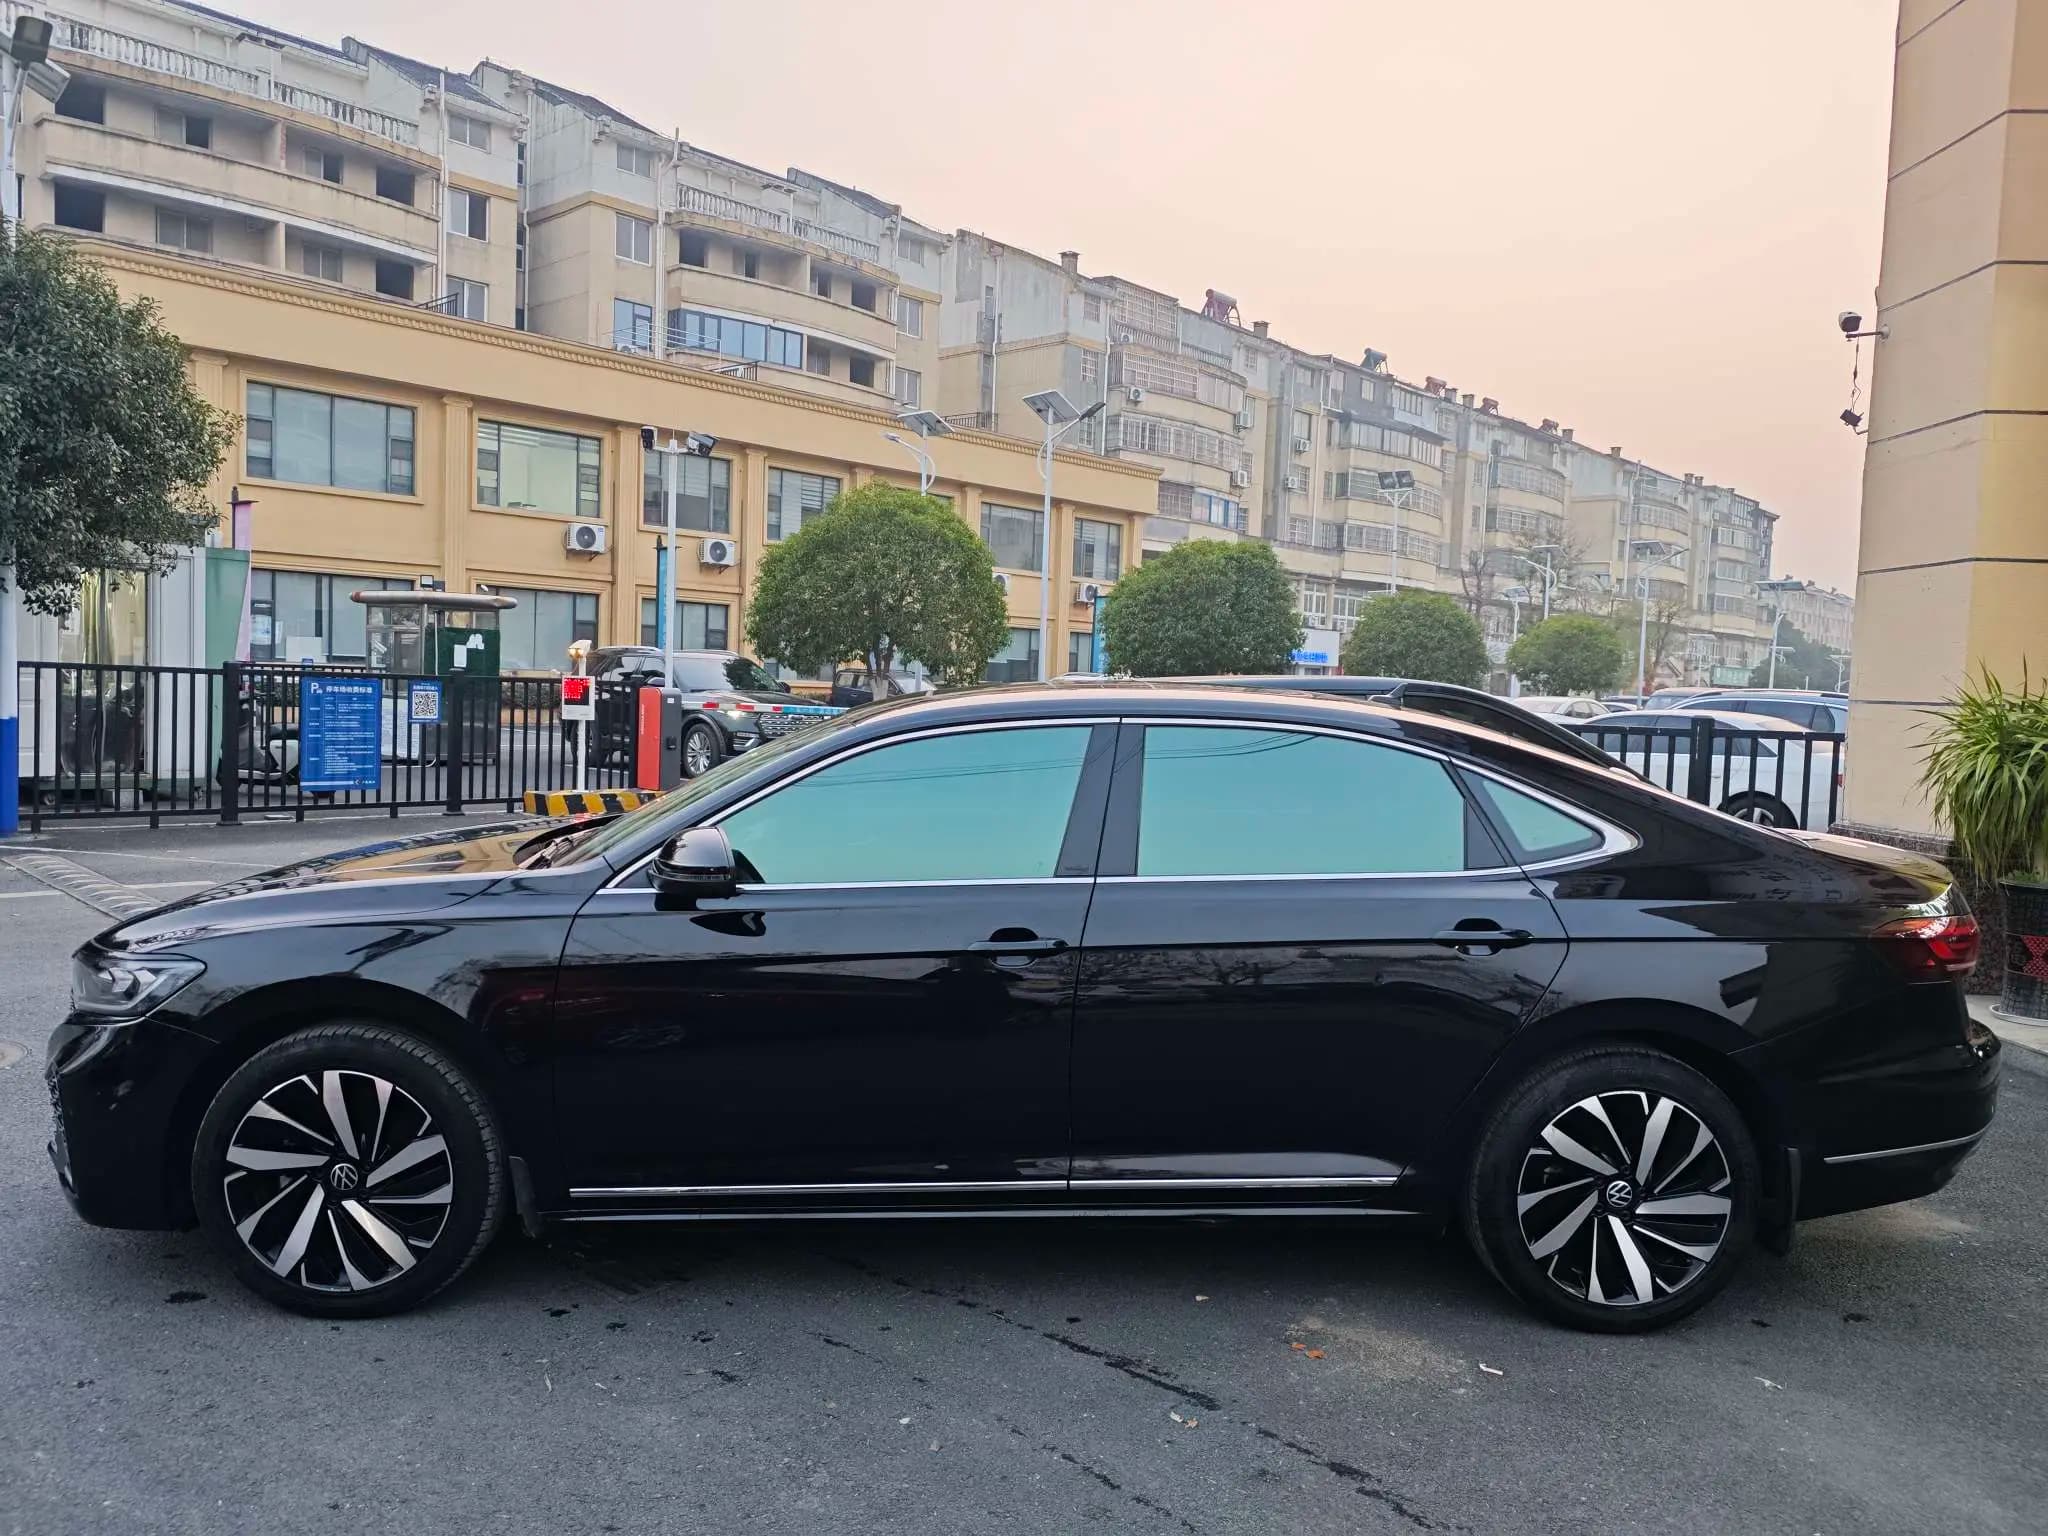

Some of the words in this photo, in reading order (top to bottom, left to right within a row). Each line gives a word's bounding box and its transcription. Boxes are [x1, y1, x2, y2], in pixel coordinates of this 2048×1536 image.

[310, 682, 319, 694] P
[325, 685, 373, 694] 停车场收费标准
[1607, 1181, 1632, 1207] VW
